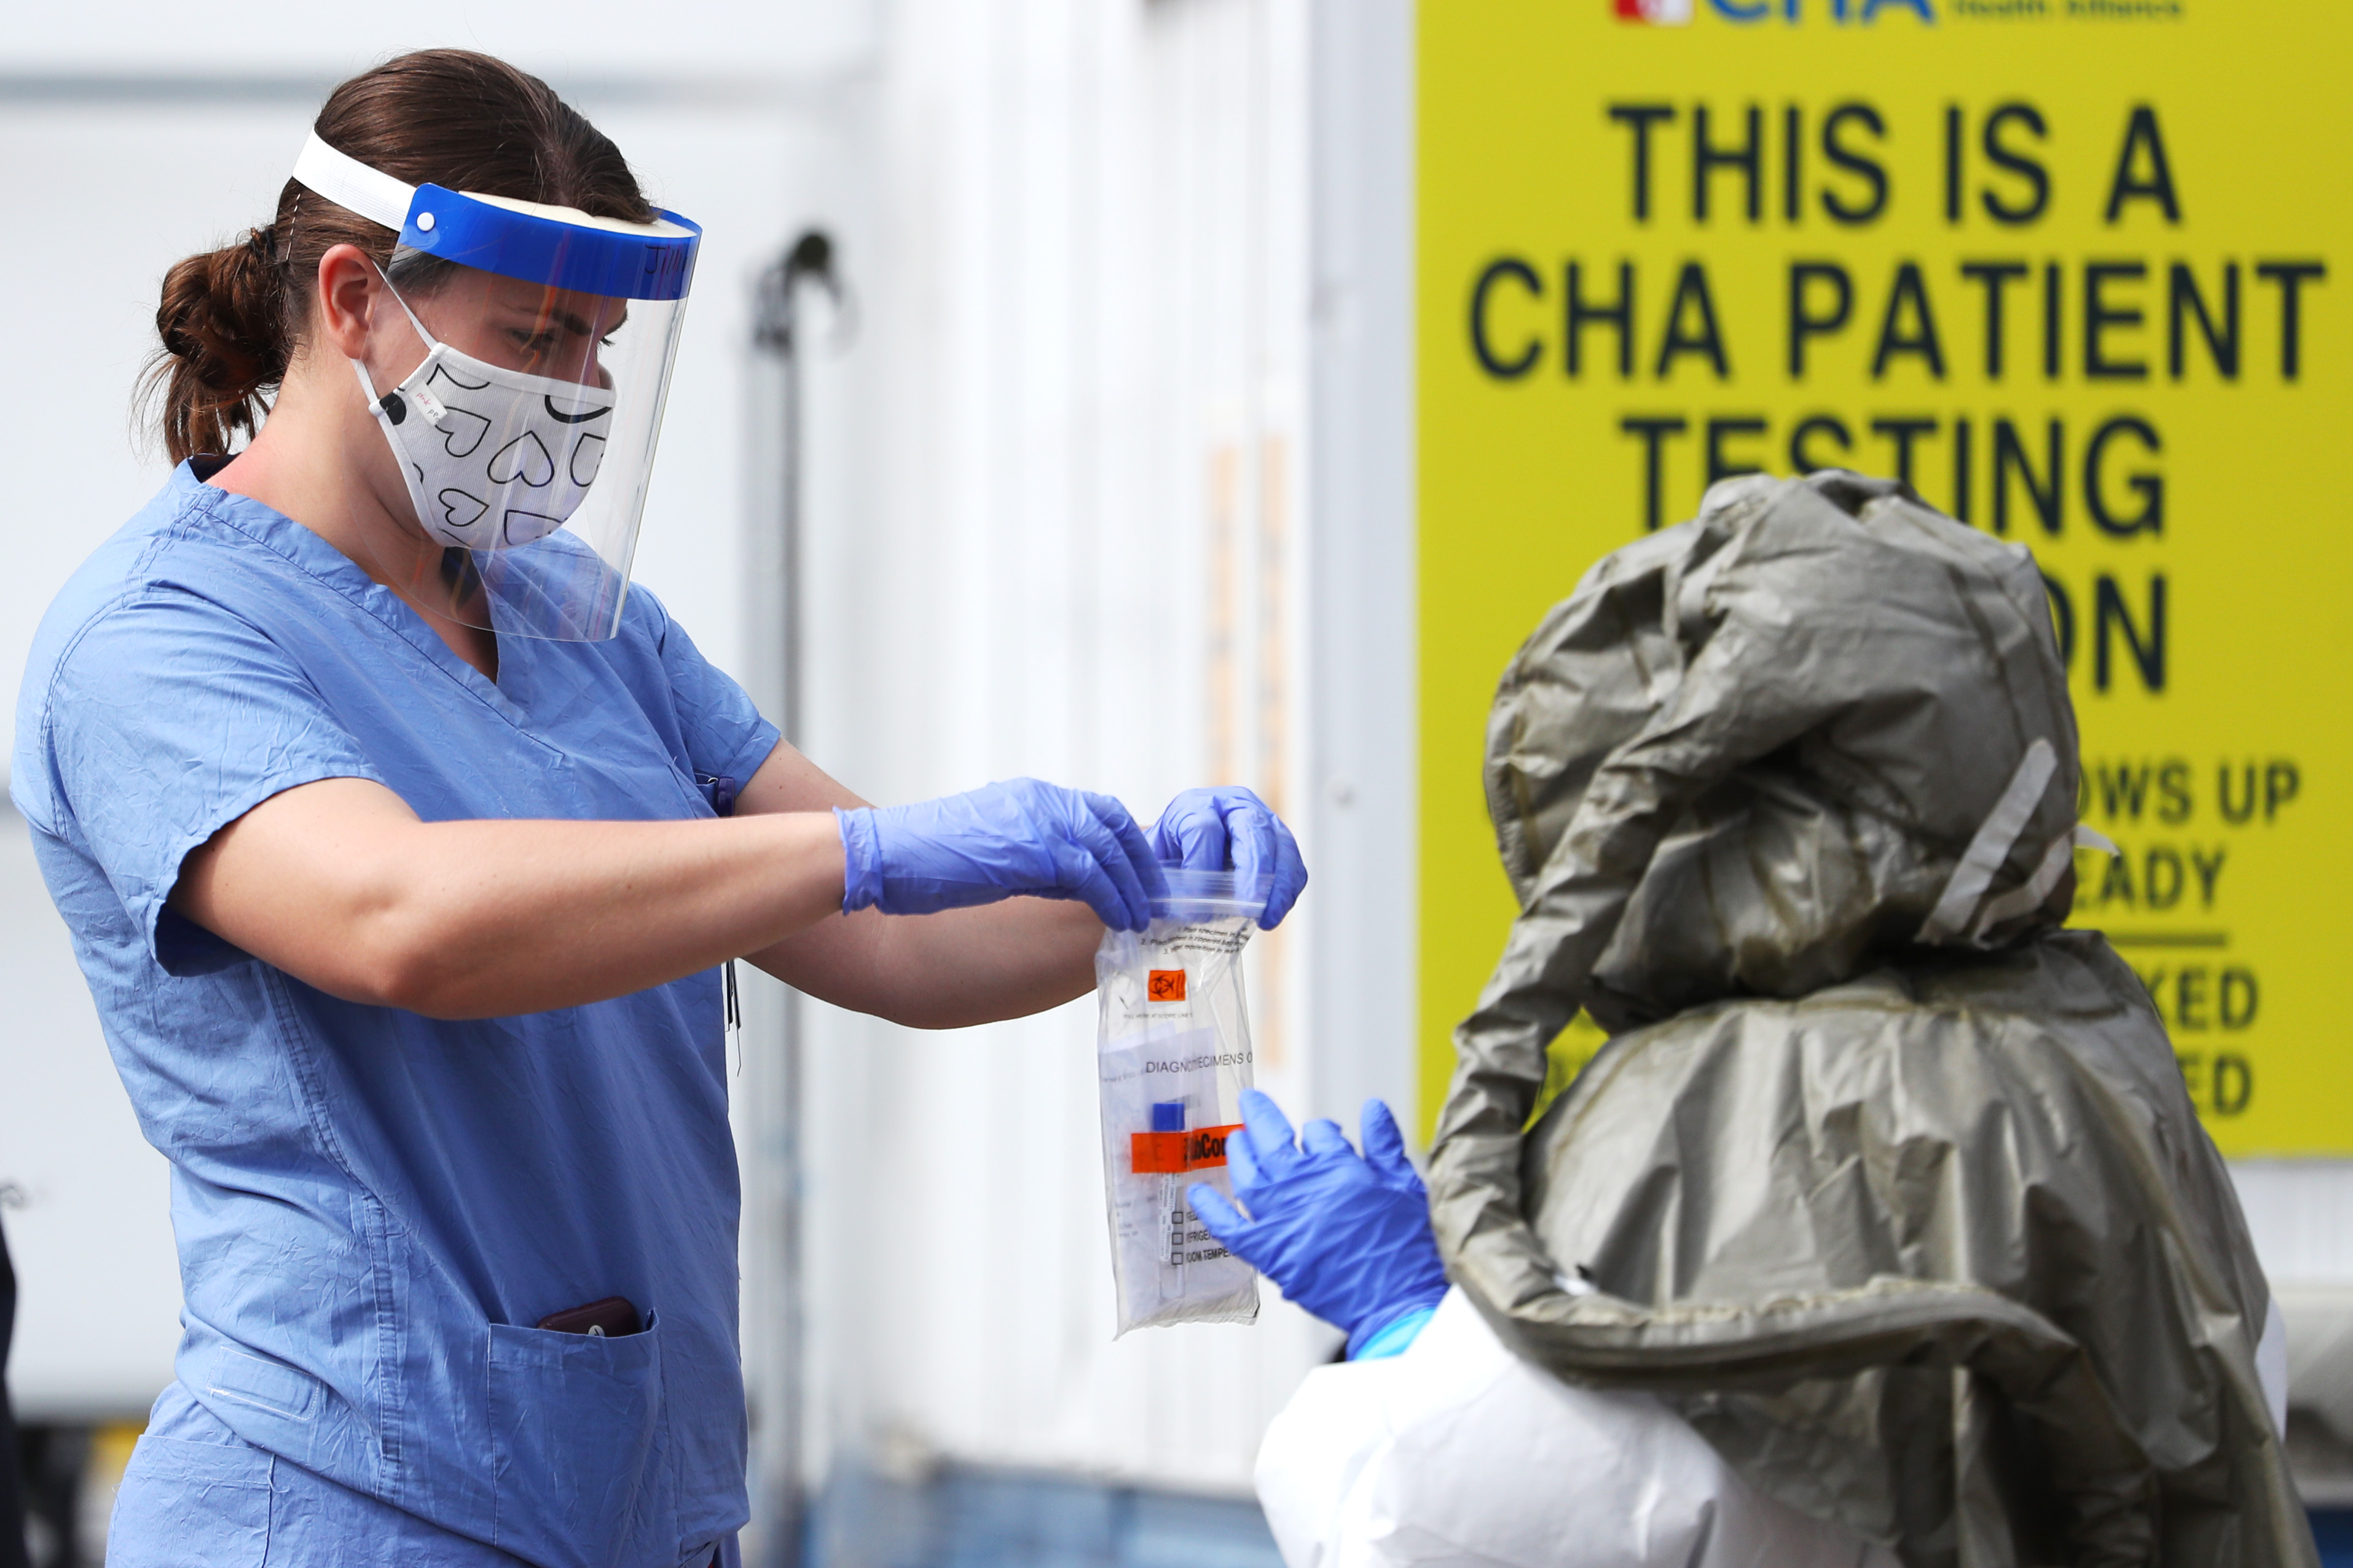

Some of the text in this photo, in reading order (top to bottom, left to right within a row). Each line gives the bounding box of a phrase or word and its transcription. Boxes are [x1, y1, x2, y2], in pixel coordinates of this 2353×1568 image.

[1605, 101, 2183, 229] THIS IS A
[1467, 256, 2328, 383] CHA PATIENT
[2217, 761, 2301, 825] UP
